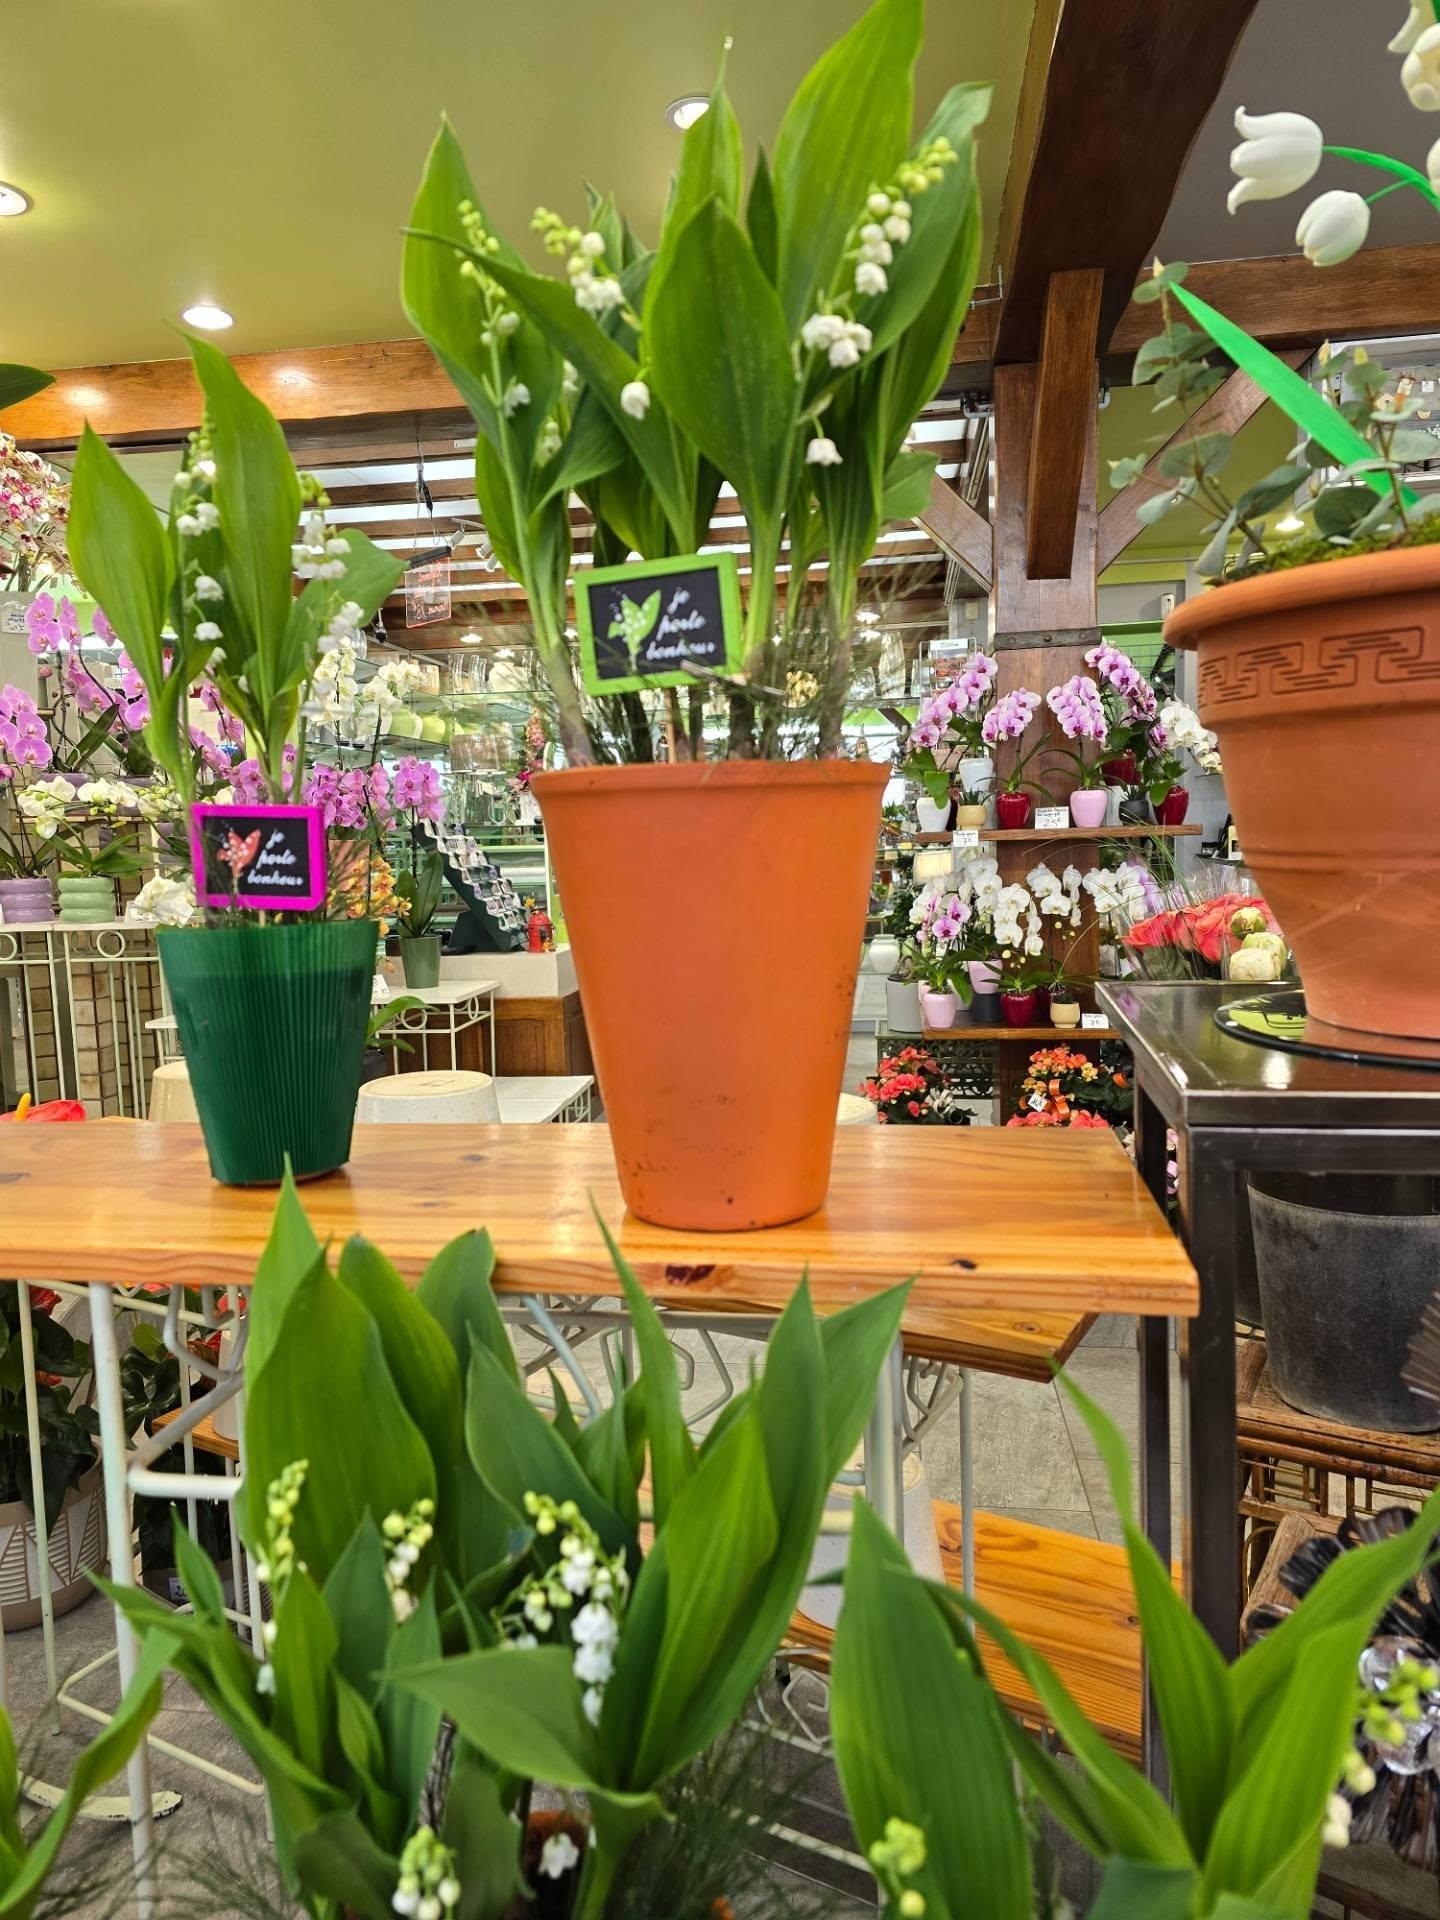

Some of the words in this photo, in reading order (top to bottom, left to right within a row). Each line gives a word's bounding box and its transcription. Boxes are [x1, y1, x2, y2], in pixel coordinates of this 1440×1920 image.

[667, 587, 690, 614] je
[656, 609, 706, 641] porte
[266, 829, 285, 850] je
[255, 848, 298, 870] porte
[247, 870, 304, 886] bonheur
